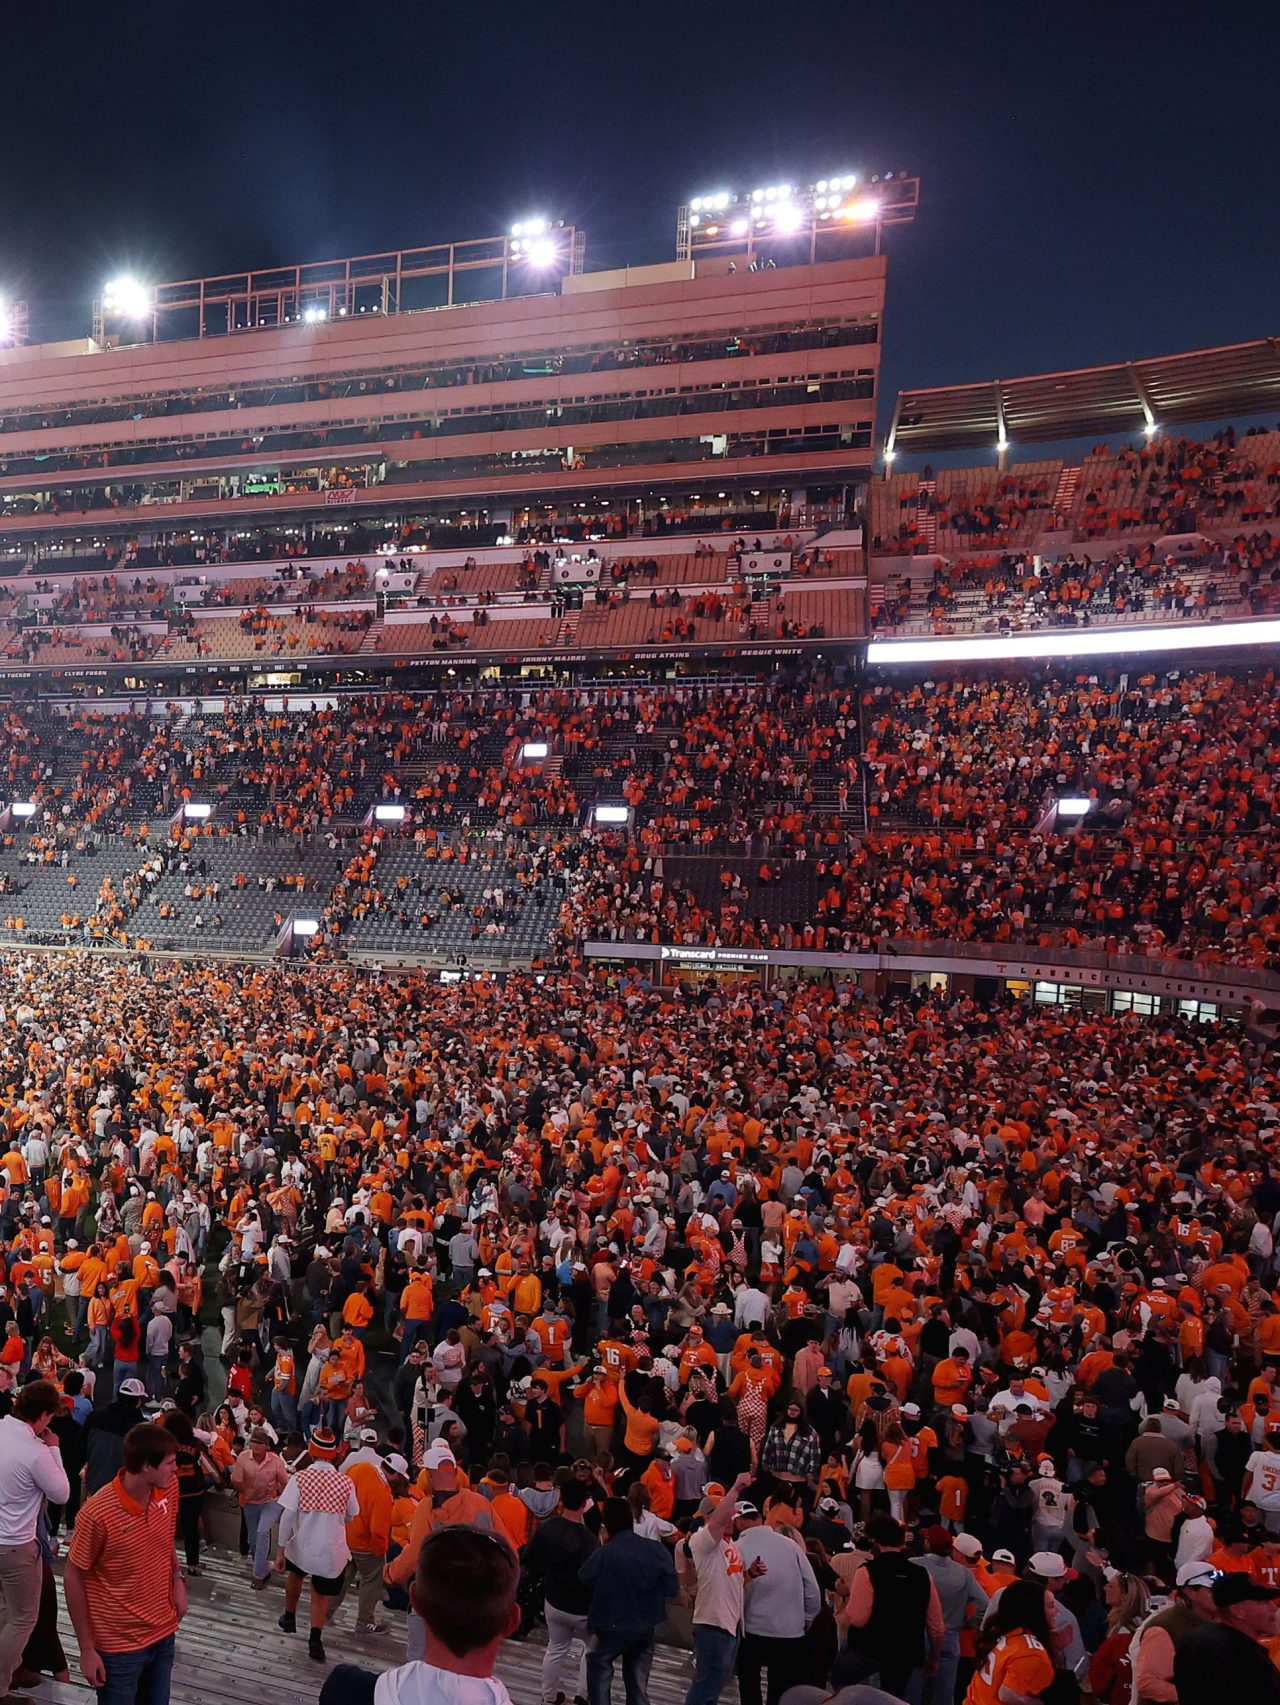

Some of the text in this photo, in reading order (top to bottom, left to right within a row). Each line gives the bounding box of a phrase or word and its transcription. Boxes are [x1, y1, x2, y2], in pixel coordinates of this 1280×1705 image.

[670, 948, 716, 959] Transcard
[1165, 983, 1235, 998] CENTER
[1178, 1222, 1190, 1236] 16
[548, 1327, 554, 1344] 1
[606, 1347, 620, 1365] 16
[537, 1409, 542, 1429] 1
[955, 1489, 961, 1506] 1
[158, 1498, 169, 1516] T
[1024, 1634, 1045, 1651] 16
